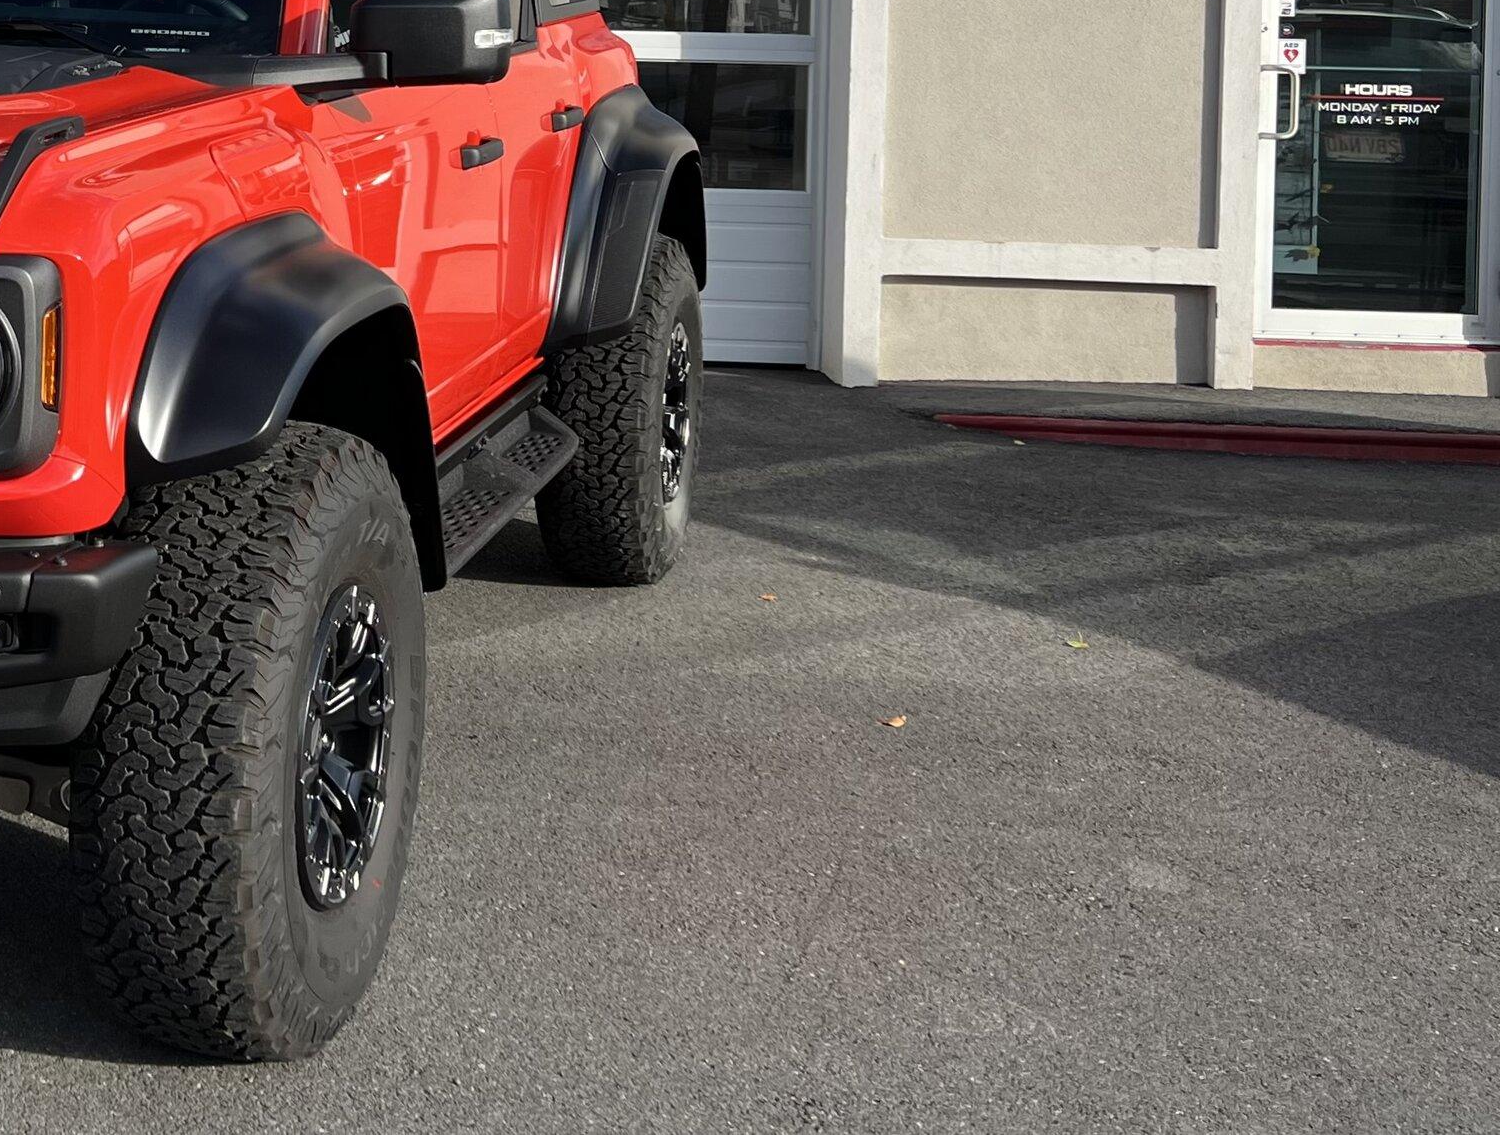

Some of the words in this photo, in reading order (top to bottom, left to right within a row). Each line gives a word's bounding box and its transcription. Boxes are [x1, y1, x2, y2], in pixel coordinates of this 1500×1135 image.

[1344, 83, 1414, 96] HOURS
[1317, 102, 1380, 113] MONDAY
[1390, 103, 1441, 114] FRIDAY
[1336, 114, 1347, 125] 8
[1350, 115, 1373, 125] AM
[1384, 115, 1394, 126] 5
[1398, 116, 1420, 126] PM
